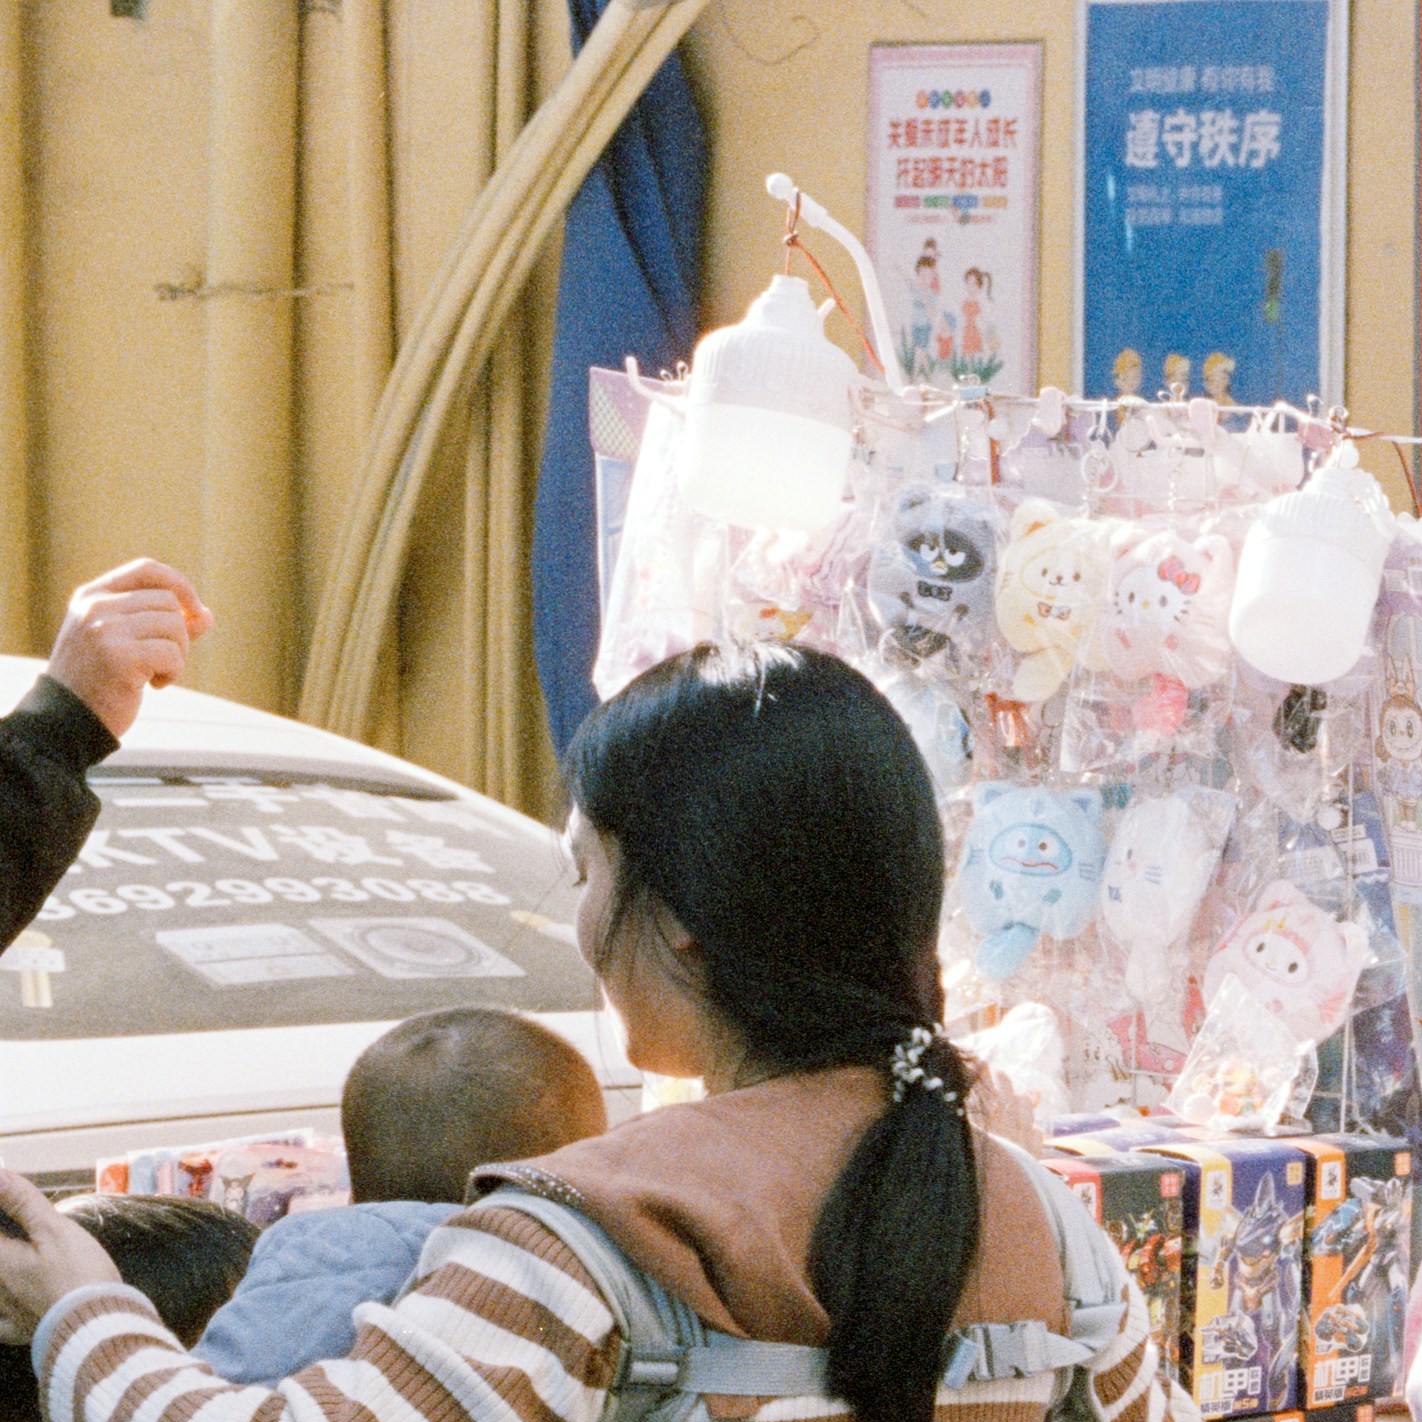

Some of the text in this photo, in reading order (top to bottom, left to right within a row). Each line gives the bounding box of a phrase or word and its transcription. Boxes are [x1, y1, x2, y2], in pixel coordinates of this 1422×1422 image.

[1126, 108, 1282, 168] 遵守秩序
[70, 825, 495, 874] KTV设备
